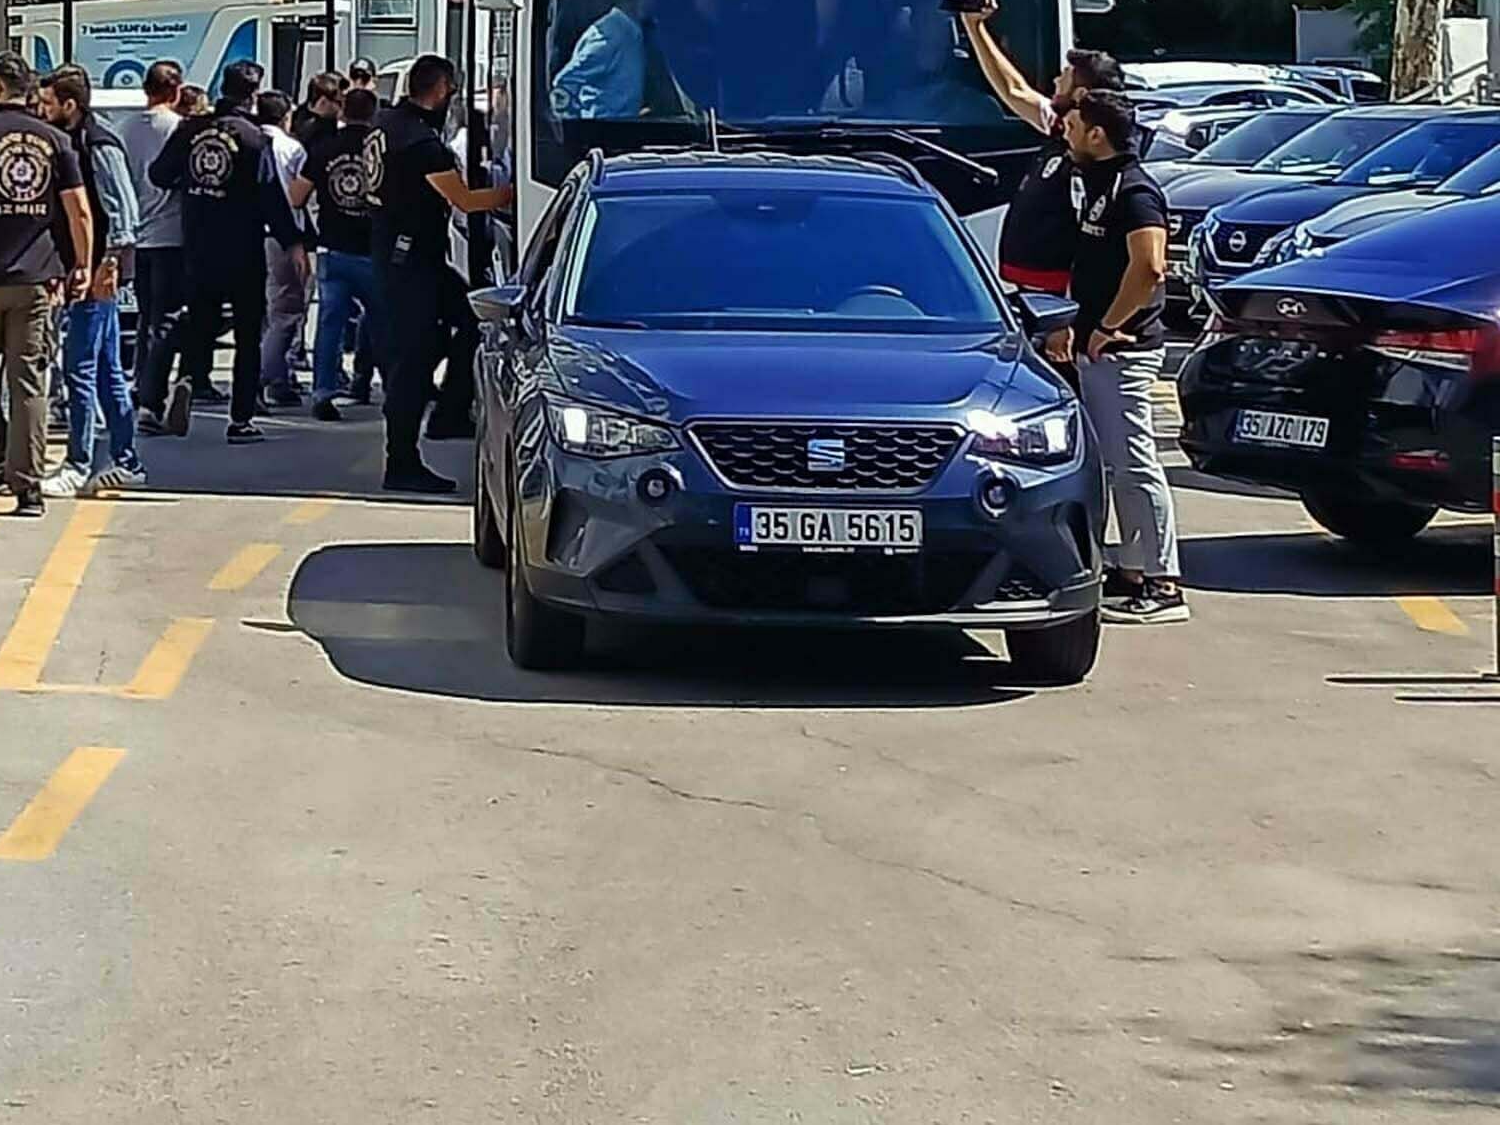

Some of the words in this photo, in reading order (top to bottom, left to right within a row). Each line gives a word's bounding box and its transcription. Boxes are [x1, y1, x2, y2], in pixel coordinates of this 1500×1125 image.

[1242, 413, 1262, 436] 35
[1300, 419, 1326, 444] 179
[756, 512, 789, 540] 35
[800, 513, 833, 542] GA
[848, 514, 915, 542] 5615
